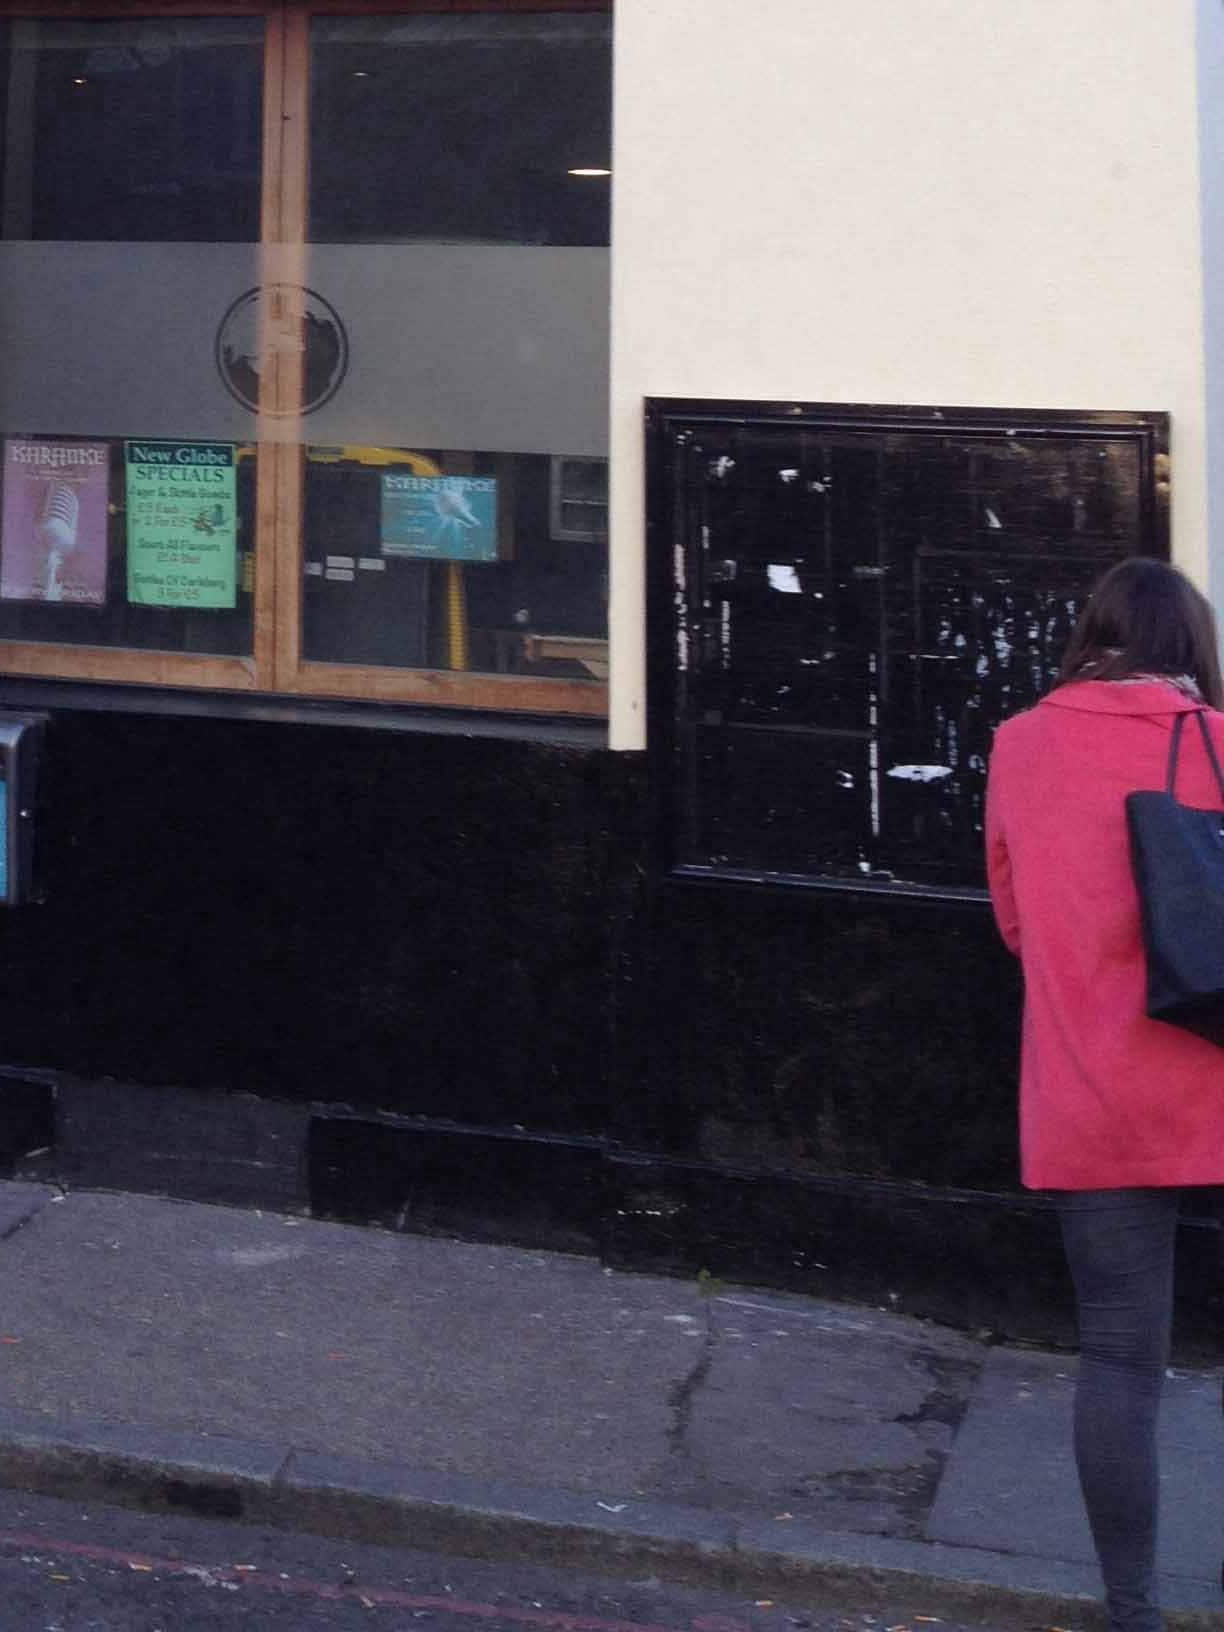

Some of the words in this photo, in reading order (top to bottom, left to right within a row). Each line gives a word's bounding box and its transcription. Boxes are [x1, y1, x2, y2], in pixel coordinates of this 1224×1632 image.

[133, 447, 172, 463] New
[175, 448, 229, 465] Globe
[136, 466, 225, 483] SPECIALS
